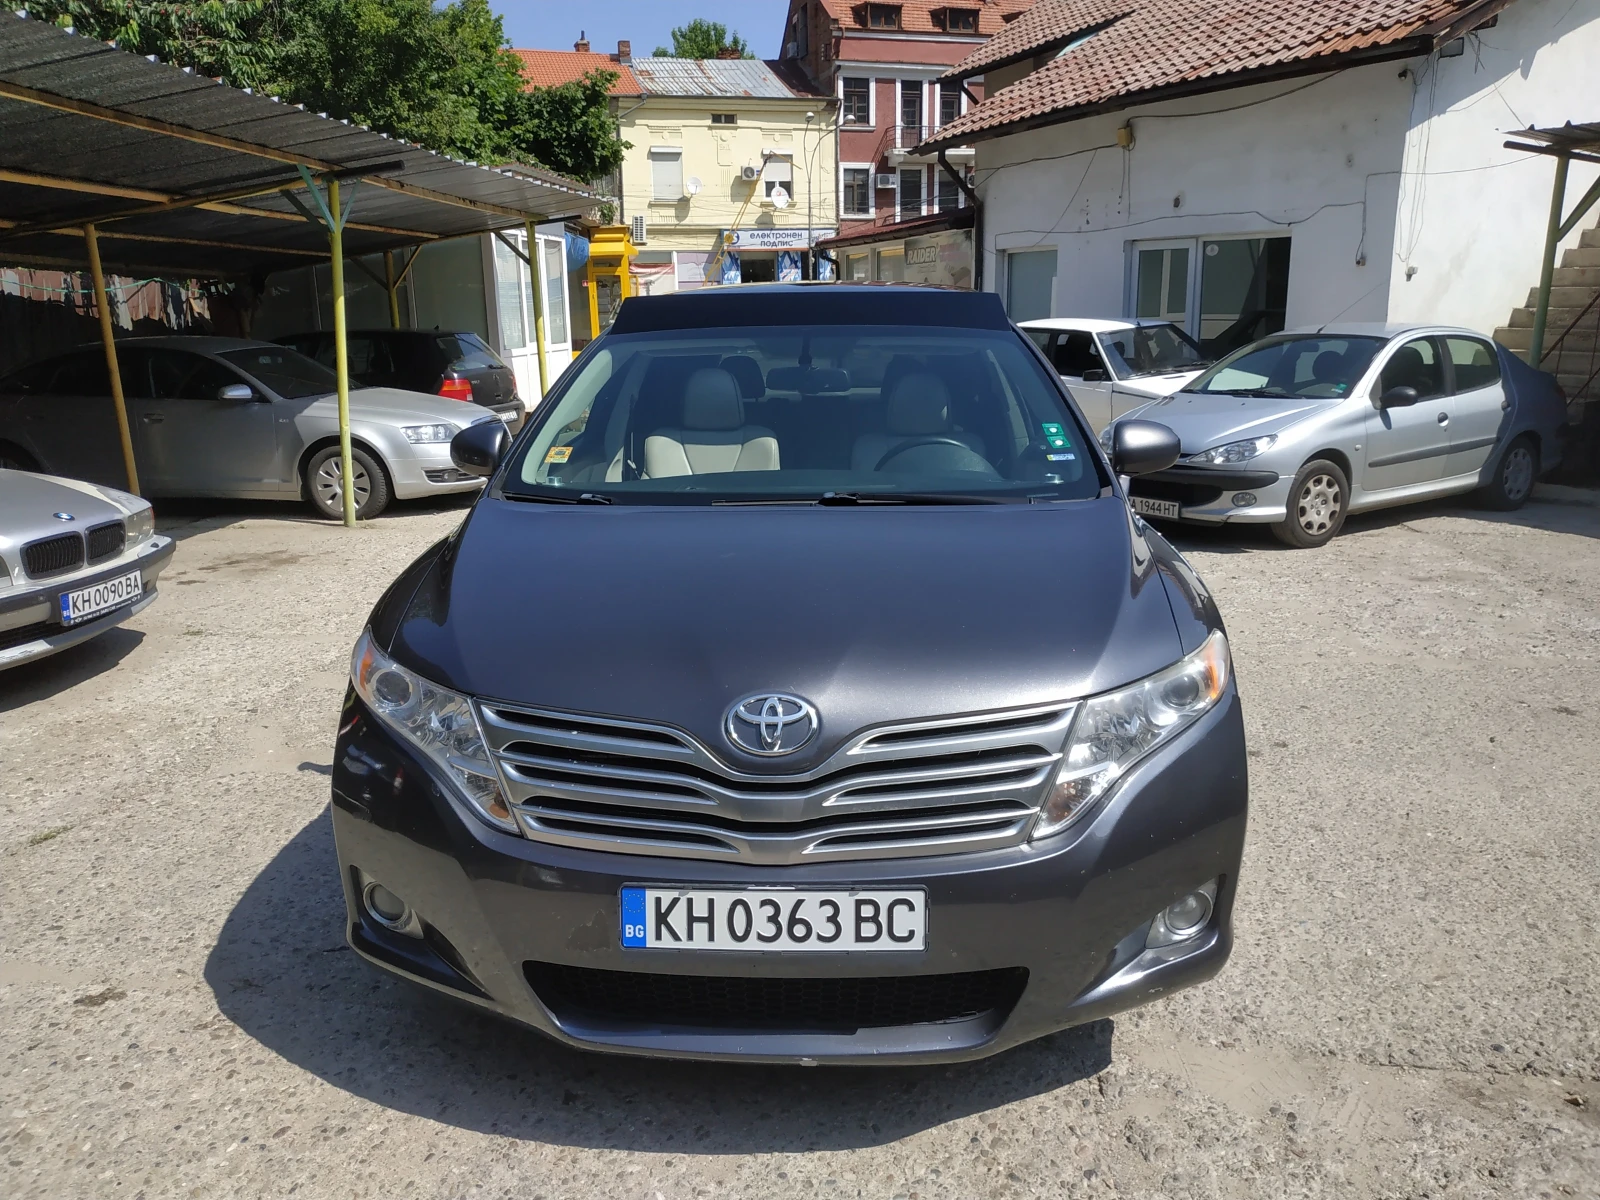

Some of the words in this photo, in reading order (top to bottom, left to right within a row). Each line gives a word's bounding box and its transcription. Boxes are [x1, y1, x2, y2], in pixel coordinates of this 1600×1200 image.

[750, 231, 803, 241] електронен
[760, 240, 794, 248] подпис
[907, 246, 936, 265] RAIDER
[1140, 499, 1162, 514] 1944
[1163, 502, 1177, 517] HT
[72, 591, 92, 615] KH
[94, 580, 124, 606] 0090
[125, 574, 140, 596] BA
[654, 896, 716, 943] KH
[726, 897, 843, 944] 0363
[853, 897, 917, 944] BC
[625, 924, 645, 938] BG
